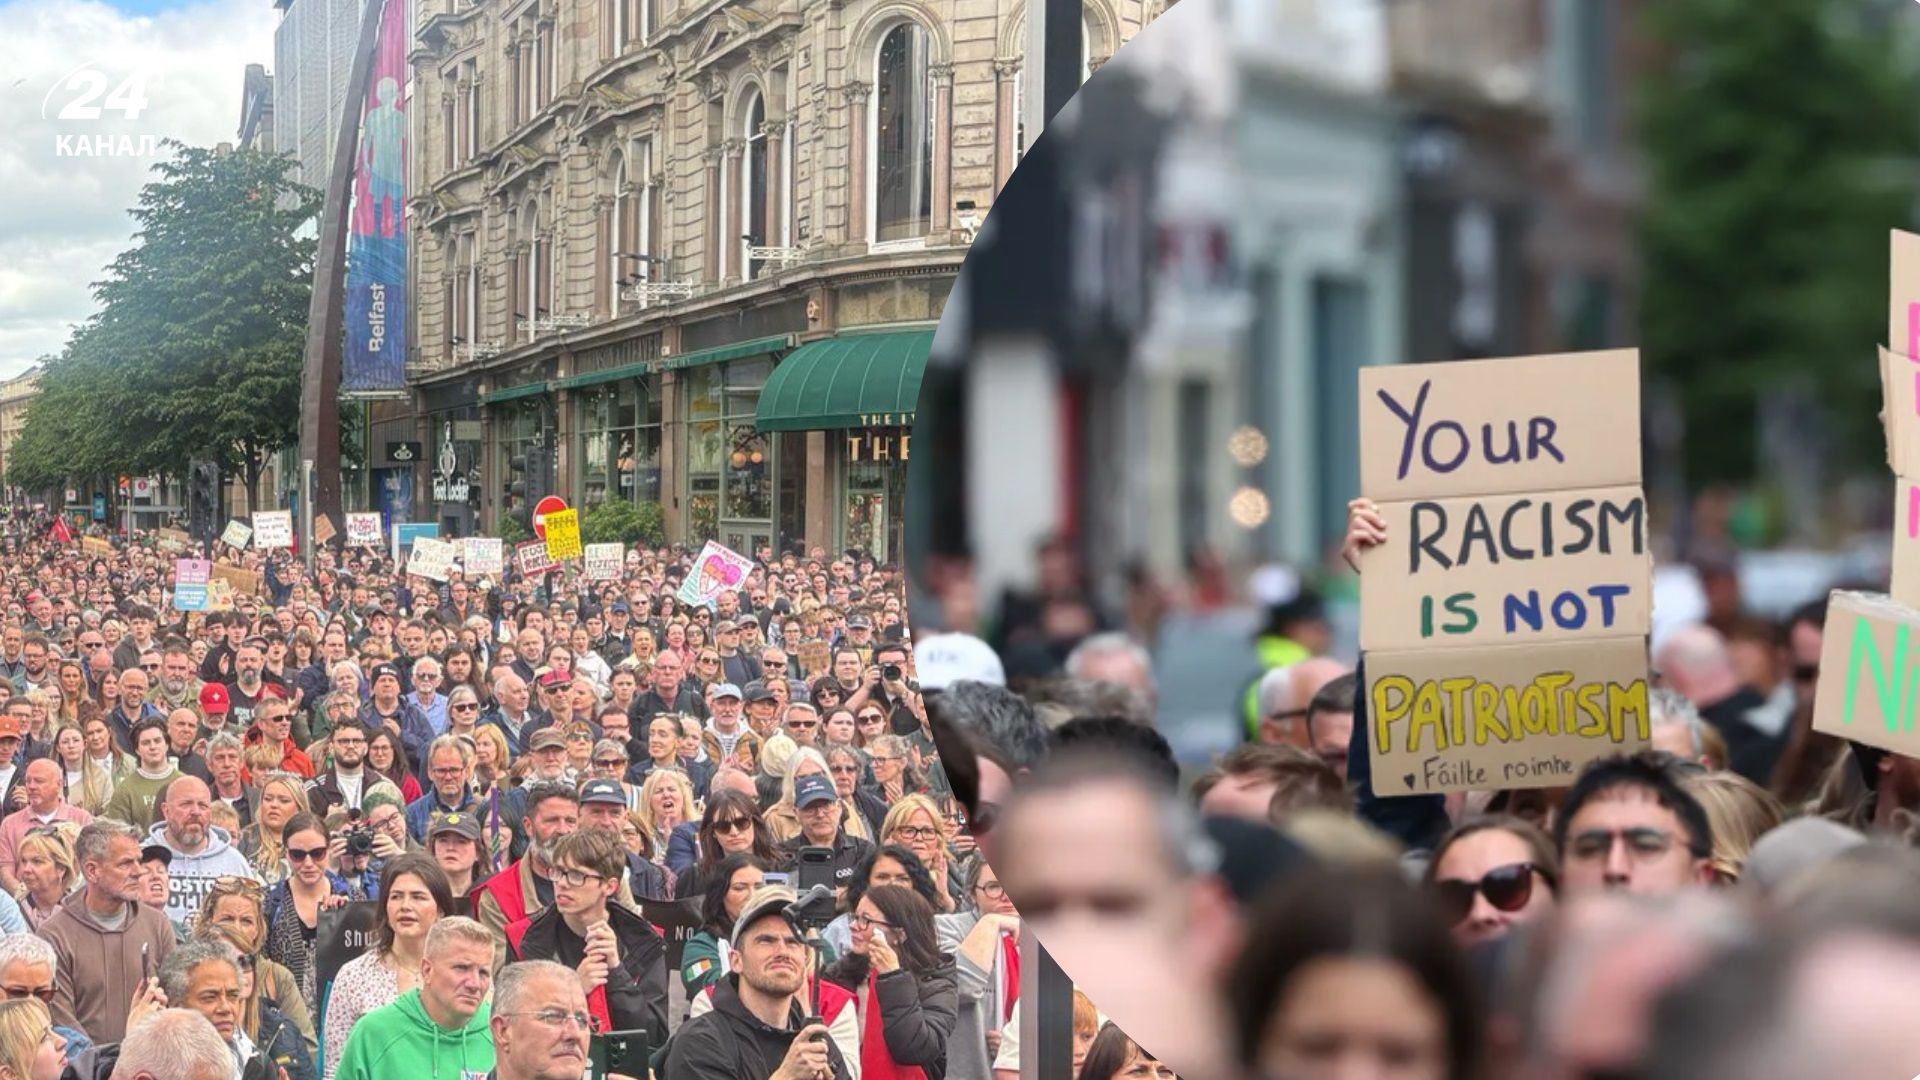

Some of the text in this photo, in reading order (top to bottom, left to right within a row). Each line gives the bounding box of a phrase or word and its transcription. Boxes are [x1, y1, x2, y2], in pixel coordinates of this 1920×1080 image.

[368, 282, 385, 352] Belfast
[860, 414, 892, 427] THE
[848, 435, 911, 461] THE
[1409, 497, 1644, 574] RACISM
[1421, 584, 1631, 638] IS NOT
[1372, 672, 1651, 754] PATRIOTISM
[1423, 756, 1487, 790] Fáilte
[1503, 757, 1573, 779] roimhe
[344, 928, 372, 948] Shu
